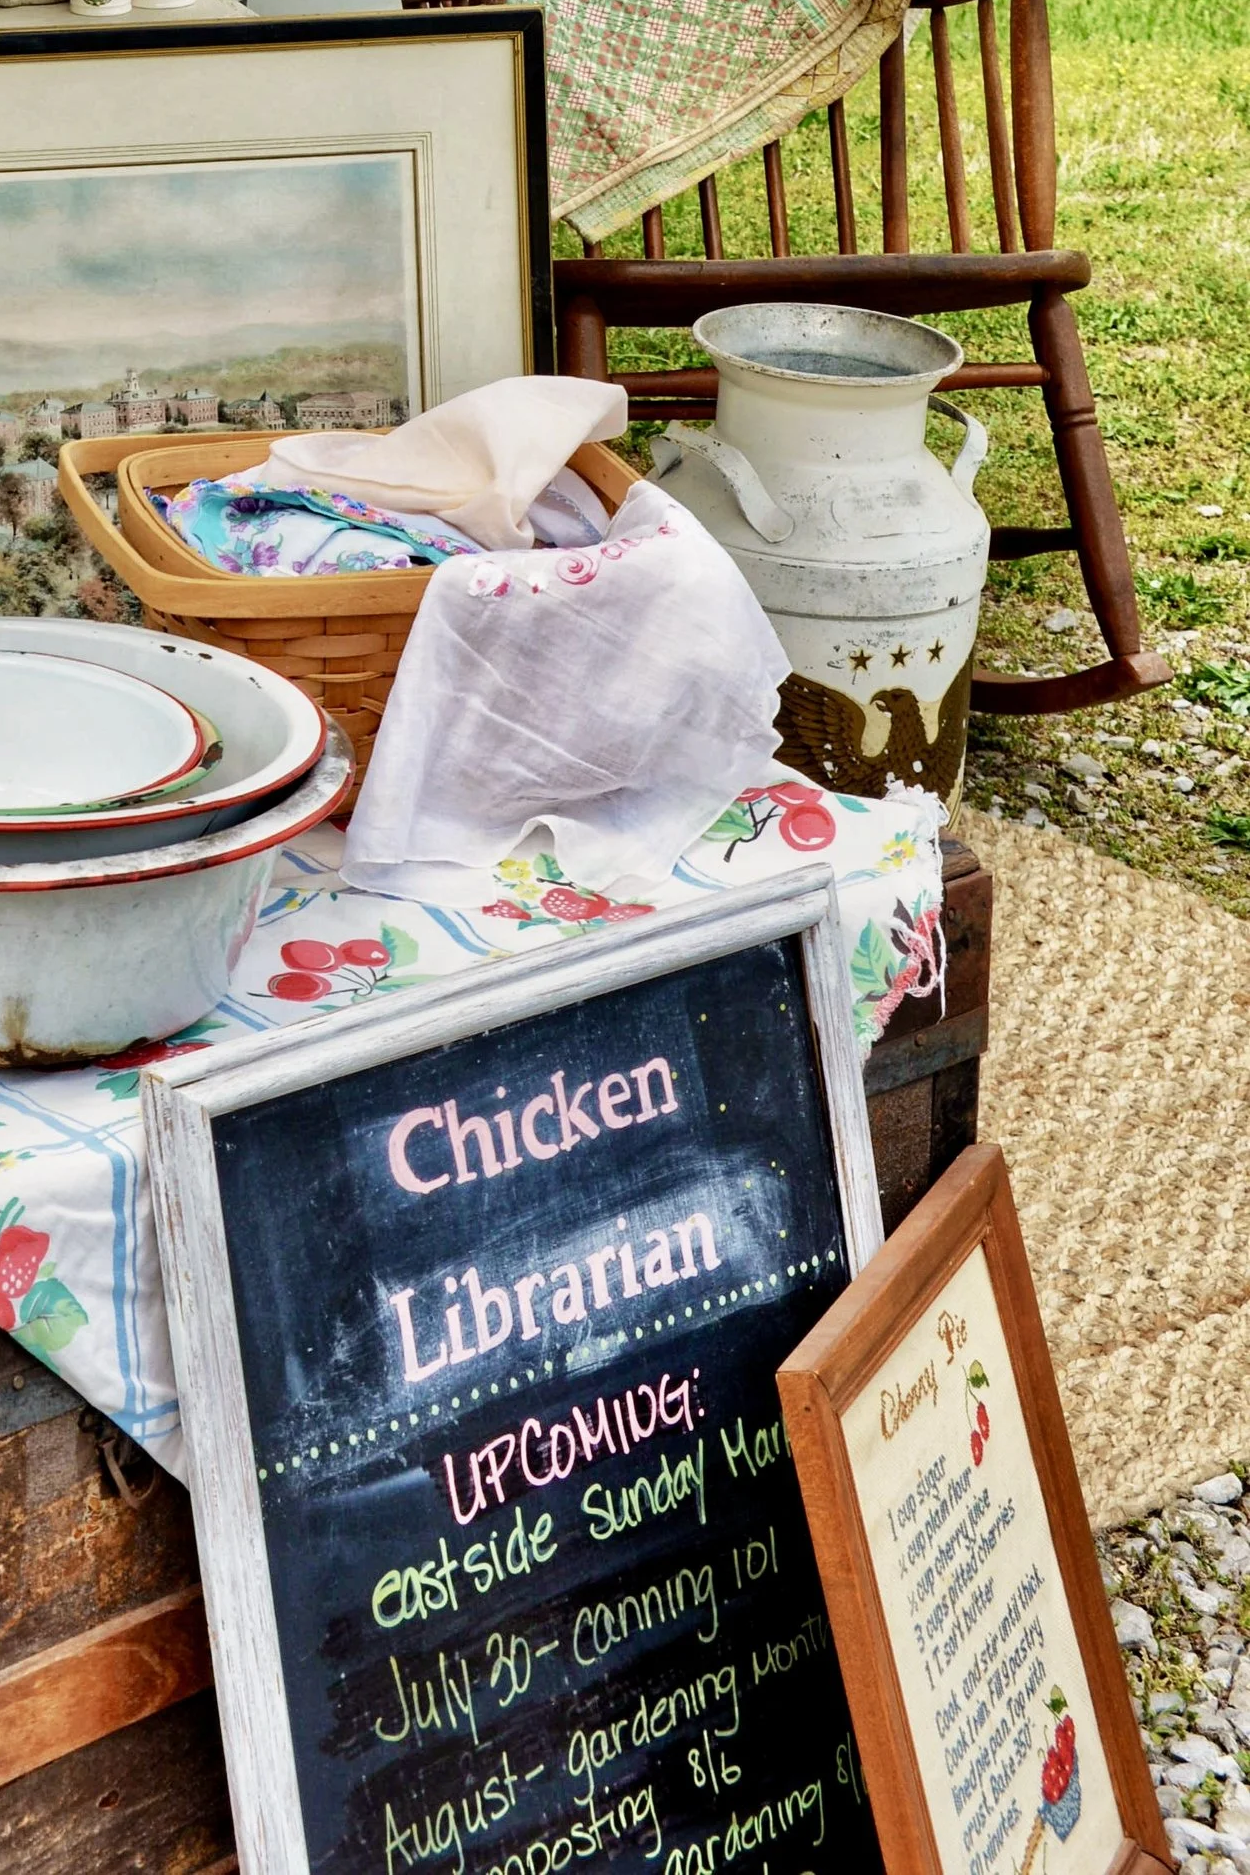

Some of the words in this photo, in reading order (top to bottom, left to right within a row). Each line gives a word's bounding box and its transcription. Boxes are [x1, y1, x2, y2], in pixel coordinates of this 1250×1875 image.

[389, 1056, 679, 1194] Chicken
[389, 1212, 722, 1382] Librarian
[880, 1359, 938, 1441] Cherry
[936, 1310, 967, 1365] Pie
[888, 1508, 898, 1541] 1
[897, 1493, 917, 1528] cup
[916, 1454, 946, 1505] sugar
[908, 1530, 925, 1565] cup
[925, 1498, 951, 1549] plain
[948, 1466, 972, 1510] flour
[916, 1566, 934, 1603] cup
[935, 1519, 970, 1576] cherry
[966, 1488, 990, 1545] juice
[376, 1652, 479, 1744] July
[573, 1565, 719, 1643] canning
[733, 1526, 778, 1589] 101
[914, 1623, 925, 1653] 3
[926, 1594, 949, 1640] cups
[948, 1546, 979, 1616] pitted
[978, 1498, 1016, 1565] cherries
[944, 1616, 965, 1666] soft
[962, 1577, 994, 1634] butter
[936, 1689, 961, 1740] Cook
[962, 1653, 981, 1701] and
[981, 1632, 999, 1674] stir
[999, 1594, 1022, 1643] until
[945, 1726, 969, 1776] Cook
[987, 1668, 1004, 1708] Fill
[1009, 1614, 1045, 1686] pastry
[568, 1665, 739, 1806] gardening
[688, 1730, 741, 1794] 8/6
[951, 1759, 977, 1817] lined
[975, 1745, 991, 1789] pie
[1007, 1691, 1026, 1727] Top
[1024, 1657, 1046, 1701] with
[990, 1755, 1016, 1805] Bake
[982, 1798, 1022, 1873] minutes
